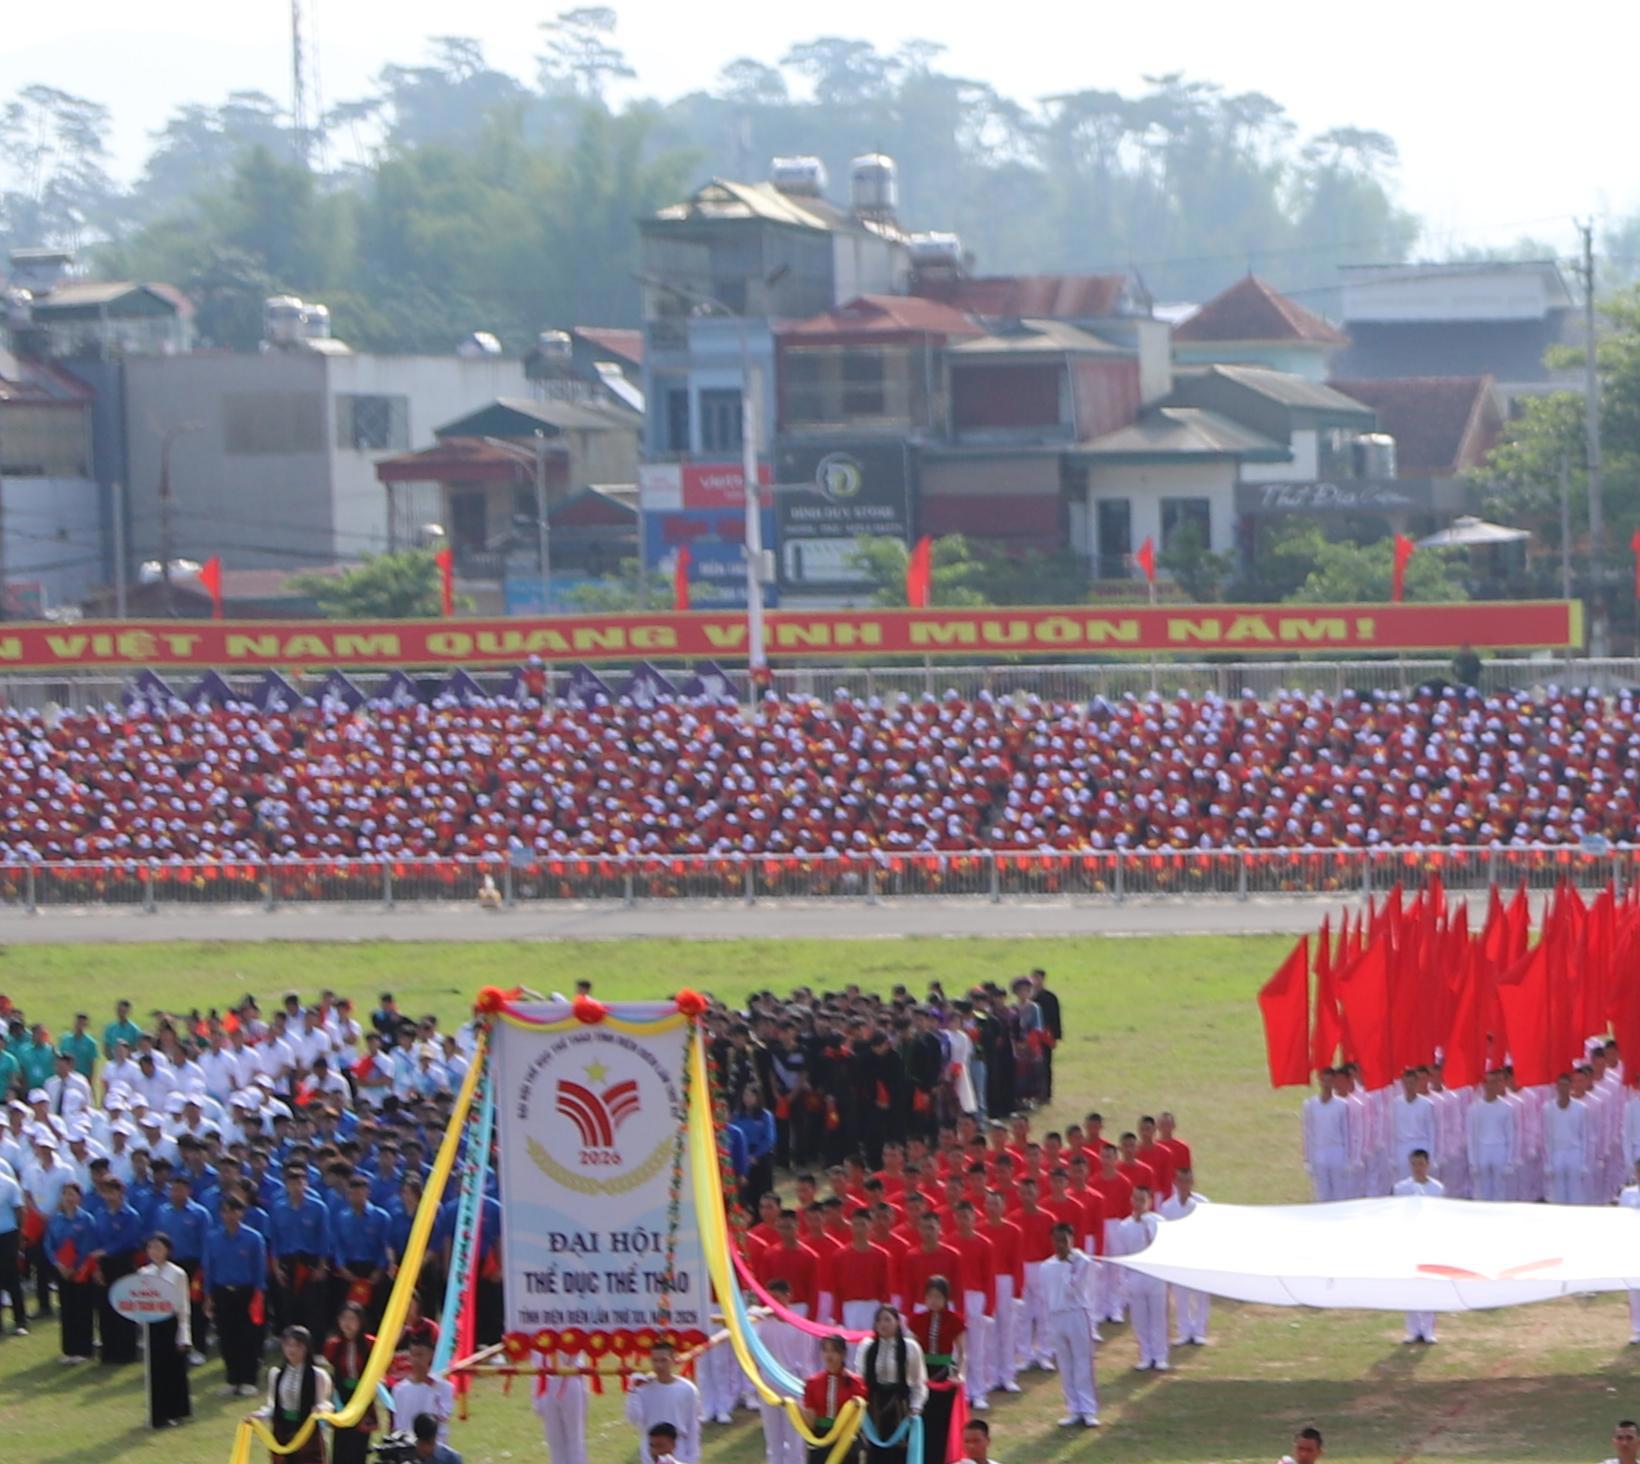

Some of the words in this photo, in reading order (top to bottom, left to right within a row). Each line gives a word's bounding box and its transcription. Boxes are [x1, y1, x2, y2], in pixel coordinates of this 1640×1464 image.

[46, 630, 200, 660] VIỆT
[226, 634, 400, 658] NAM
[427, 625, 678, 656] QUANG
[909, 617, 1141, 644] MUÔN
[1167, 615, 1377, 642] NĂM!
[579, 1150, 622, 1165] 2026
[548, 1231, 601, 1258] ĐẠI
[609, 1226, 663, 1258] HỘI
[524, 1262, 559, 1294] THỂ
[563, 1271, 600, 1300] DỤC
[605, 1262, 640, 1294] THỂ
